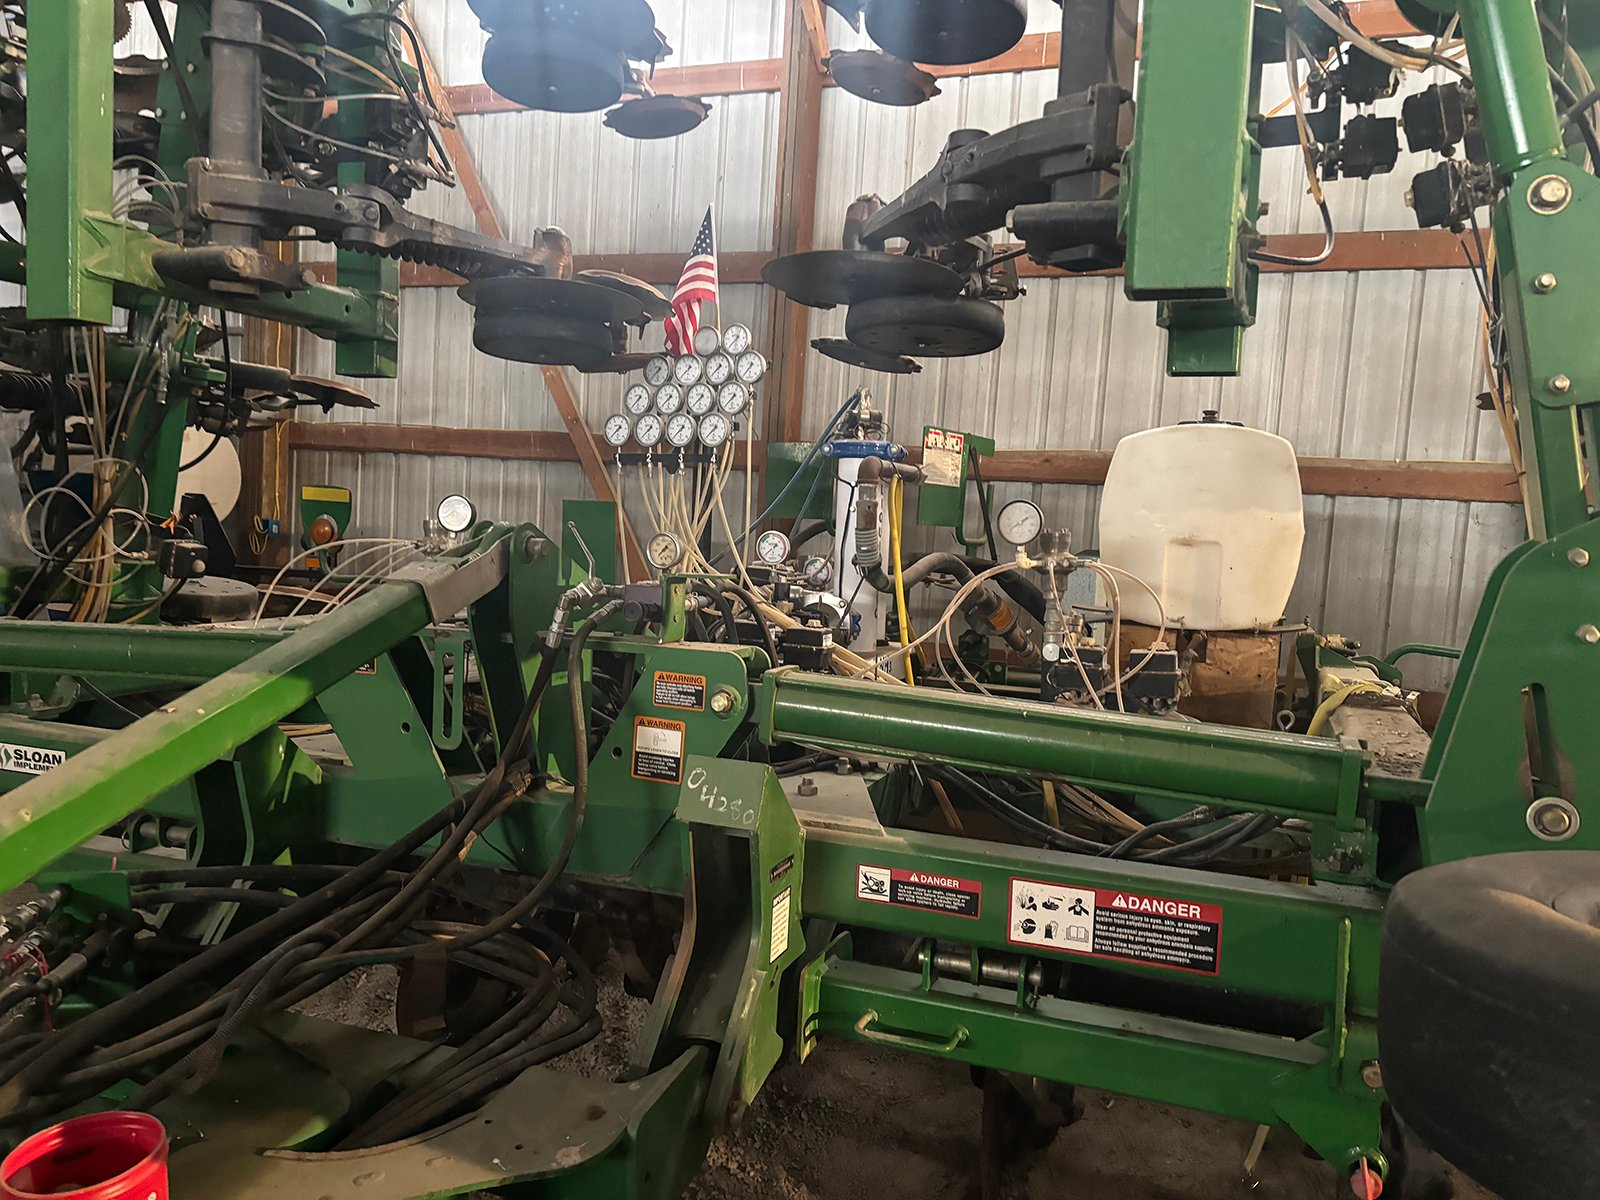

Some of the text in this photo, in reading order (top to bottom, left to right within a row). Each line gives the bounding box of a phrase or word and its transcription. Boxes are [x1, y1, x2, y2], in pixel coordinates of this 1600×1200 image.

[646, 453, 651, 462] 2
[678, 454, 683, 462] 3
[710, 454, 716, 463] 4
[666, 674, 702, 684] WARNING
[647, 720, 680, 730] WARNING
[14, 749, 62, 766] SLOAN
[14, 761, 54, 771] IMPLEME
[921, 875, 959, 888] DANGER
[1128, 896, 1201, 918] DANGER
